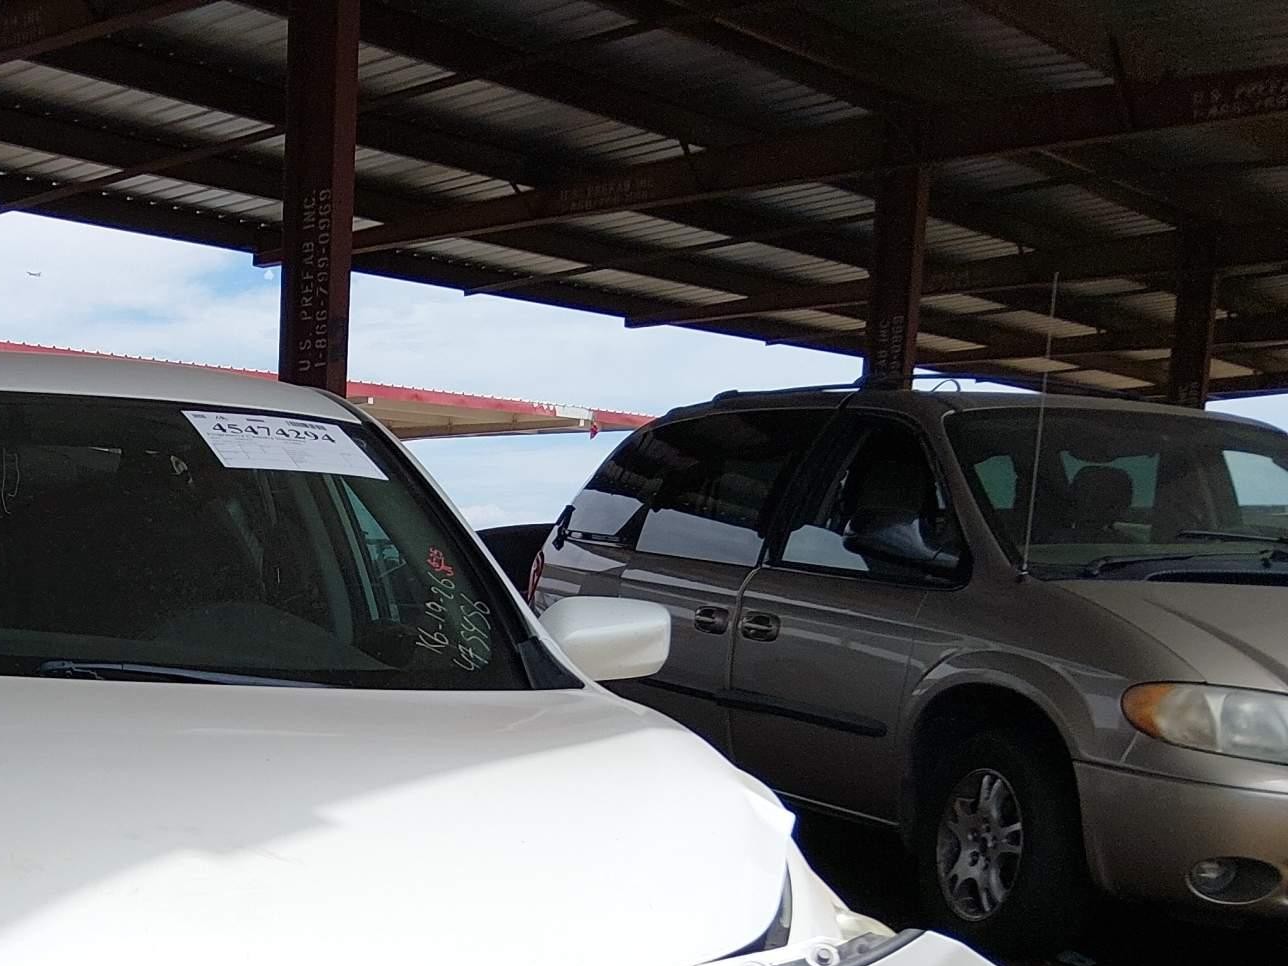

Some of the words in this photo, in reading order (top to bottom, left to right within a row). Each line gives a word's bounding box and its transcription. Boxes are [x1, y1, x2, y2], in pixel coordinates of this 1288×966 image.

[300, 241, 315, 321] PREFAB
[314, 187, 332, 369] 1-866-799-0969
[212, 421, 336, 444] 45474294
